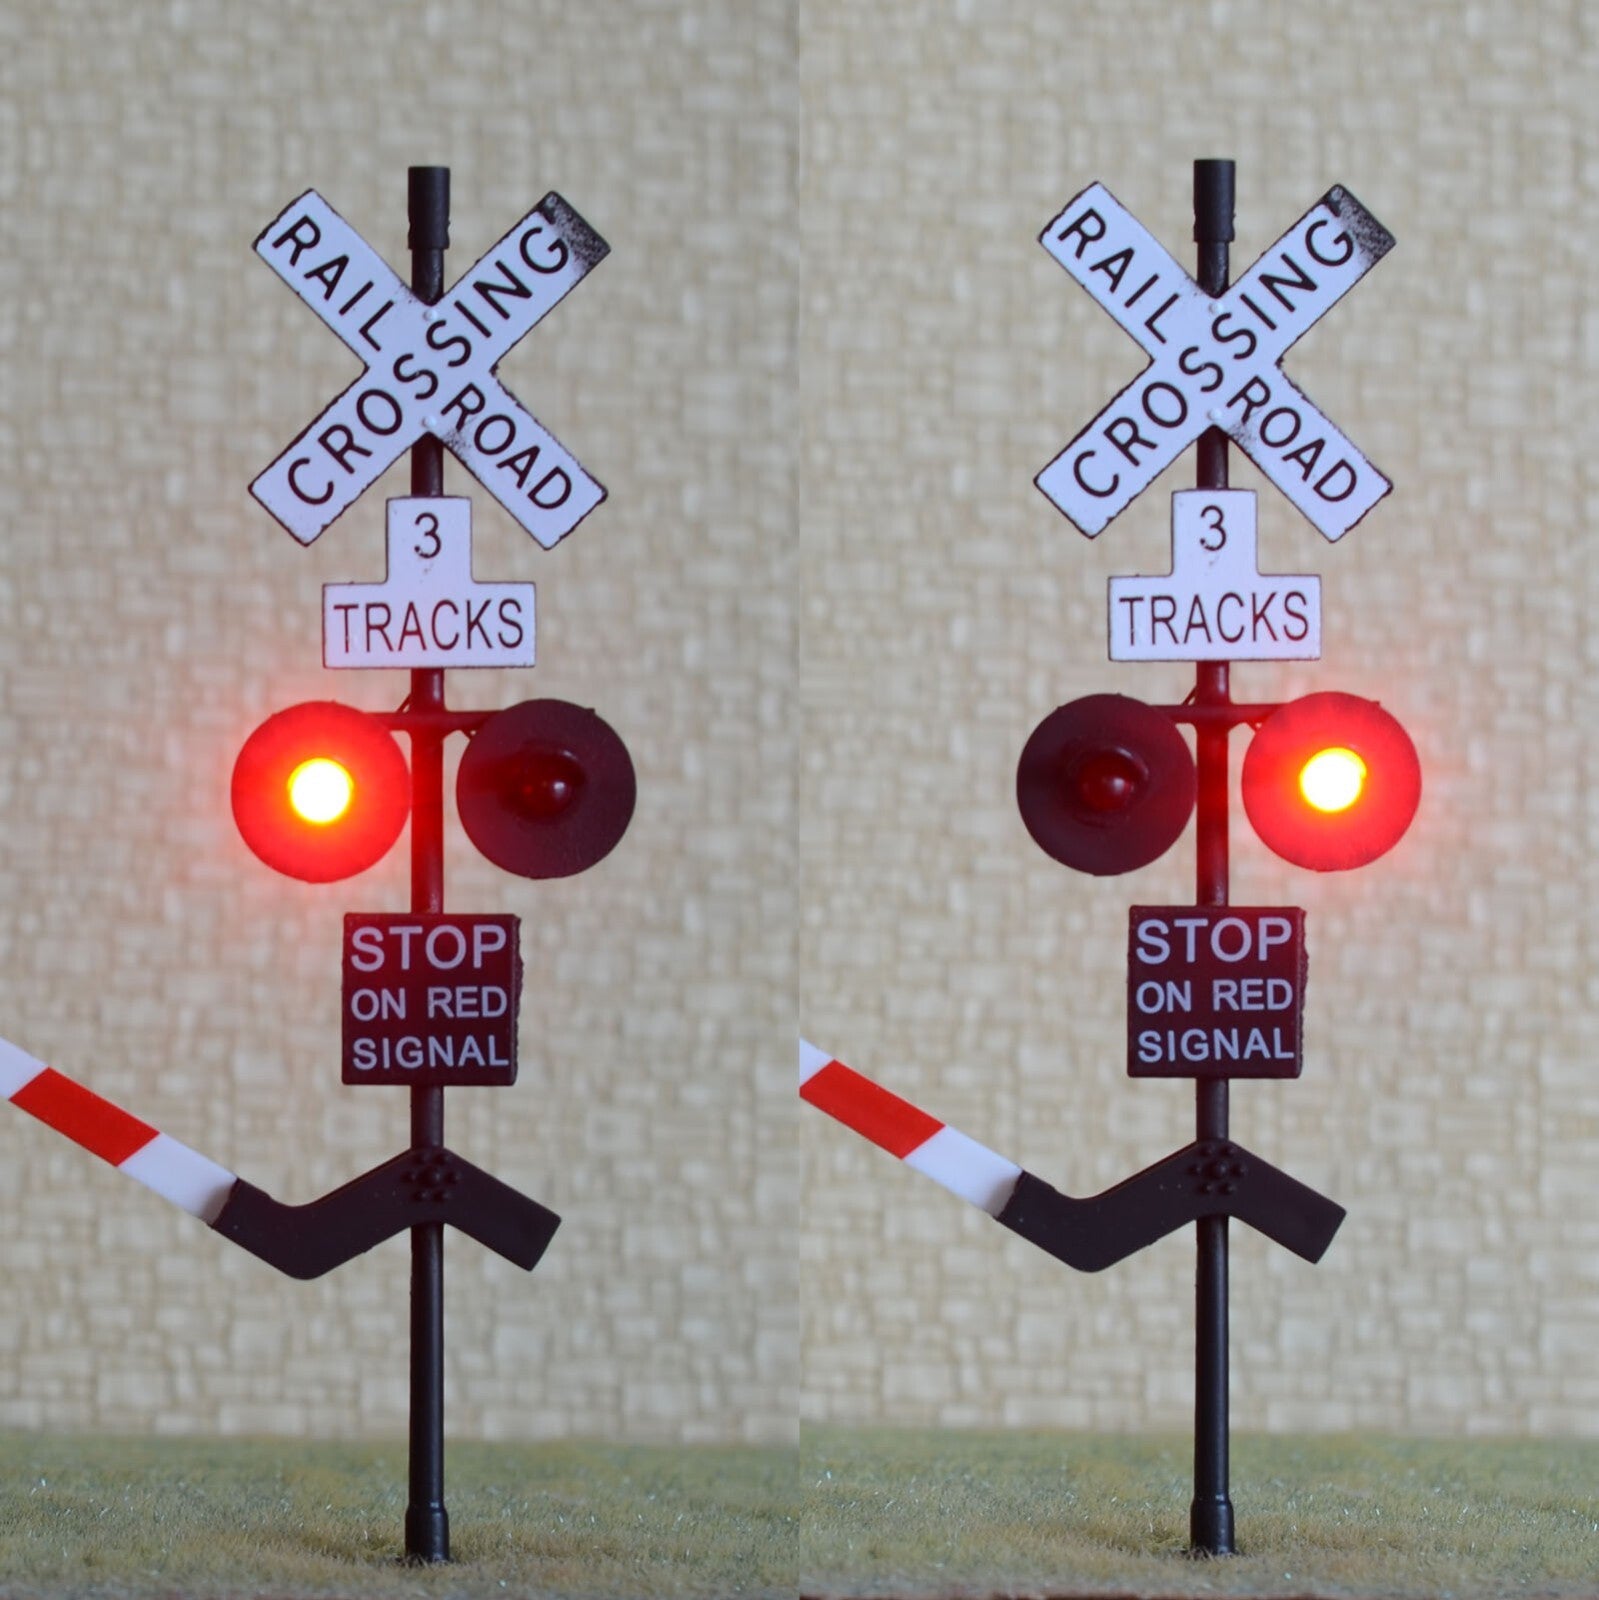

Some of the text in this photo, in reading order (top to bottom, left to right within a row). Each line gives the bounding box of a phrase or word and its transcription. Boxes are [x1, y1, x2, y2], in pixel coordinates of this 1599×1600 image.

[272, 215, 572, 510] RAIL ROAD
[288, 226, 569, 505] CROSSING
[1057, 208, 1358, 502] RAIL ROAD
[1073, 219, 1355, 498] CROSSING
[414, 512, 442, 558] 3
[1199, 505, 1227, 551] 3
[333, 598, 524, 653] TRACKS
[1119, 591, 1309, 646] TRACKS
[351, 924, 507, 972] STOP
[1136, 917, 1292, 964] STOP
[351, 986, 507, 1021] ON RED
[1136, 979, 1293, 1014] ON RED
[353, 1034, 509, 1070] SIGNAL
[1138, 1027, 1295, 1063] SIGNAL
